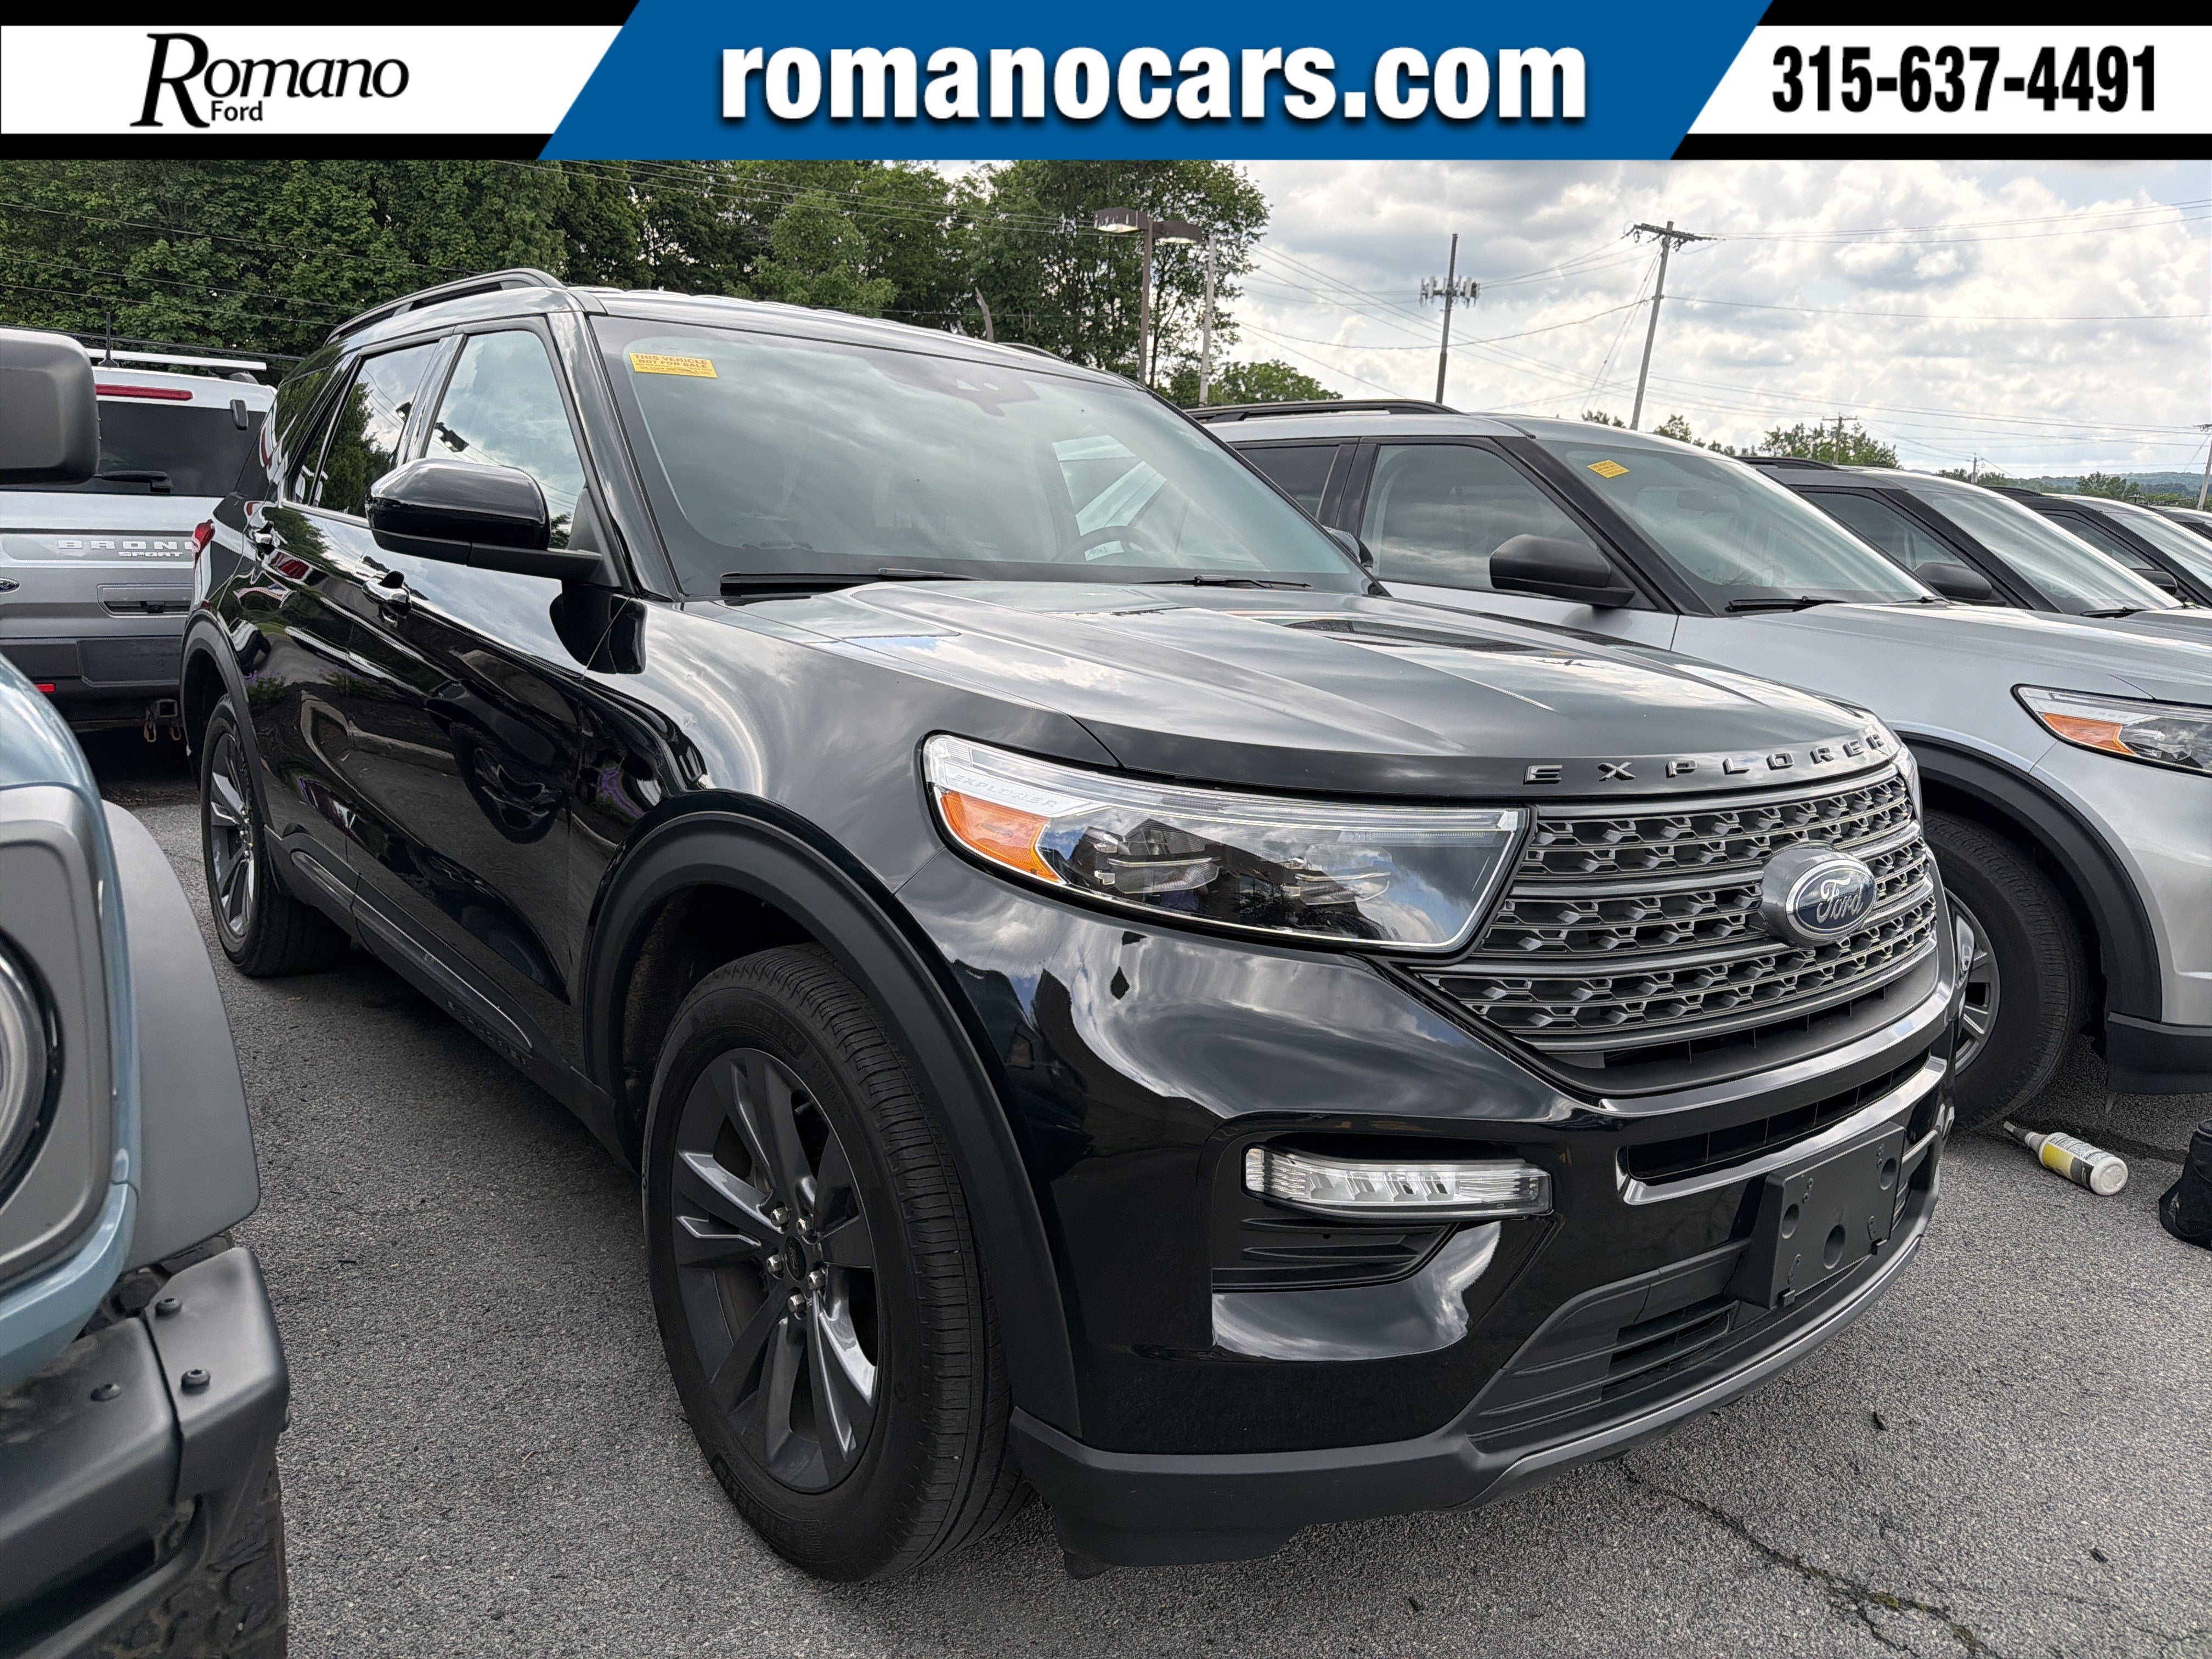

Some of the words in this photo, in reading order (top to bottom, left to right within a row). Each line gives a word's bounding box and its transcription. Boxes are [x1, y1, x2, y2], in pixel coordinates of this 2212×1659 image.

[662, 356, 708, 365] VEHICLE
[1523, 733, 1886, 785] EXPLORER
[952, 774, 1058, 808] EXPLORER
[1816, 877, 1864, 924] Ford
